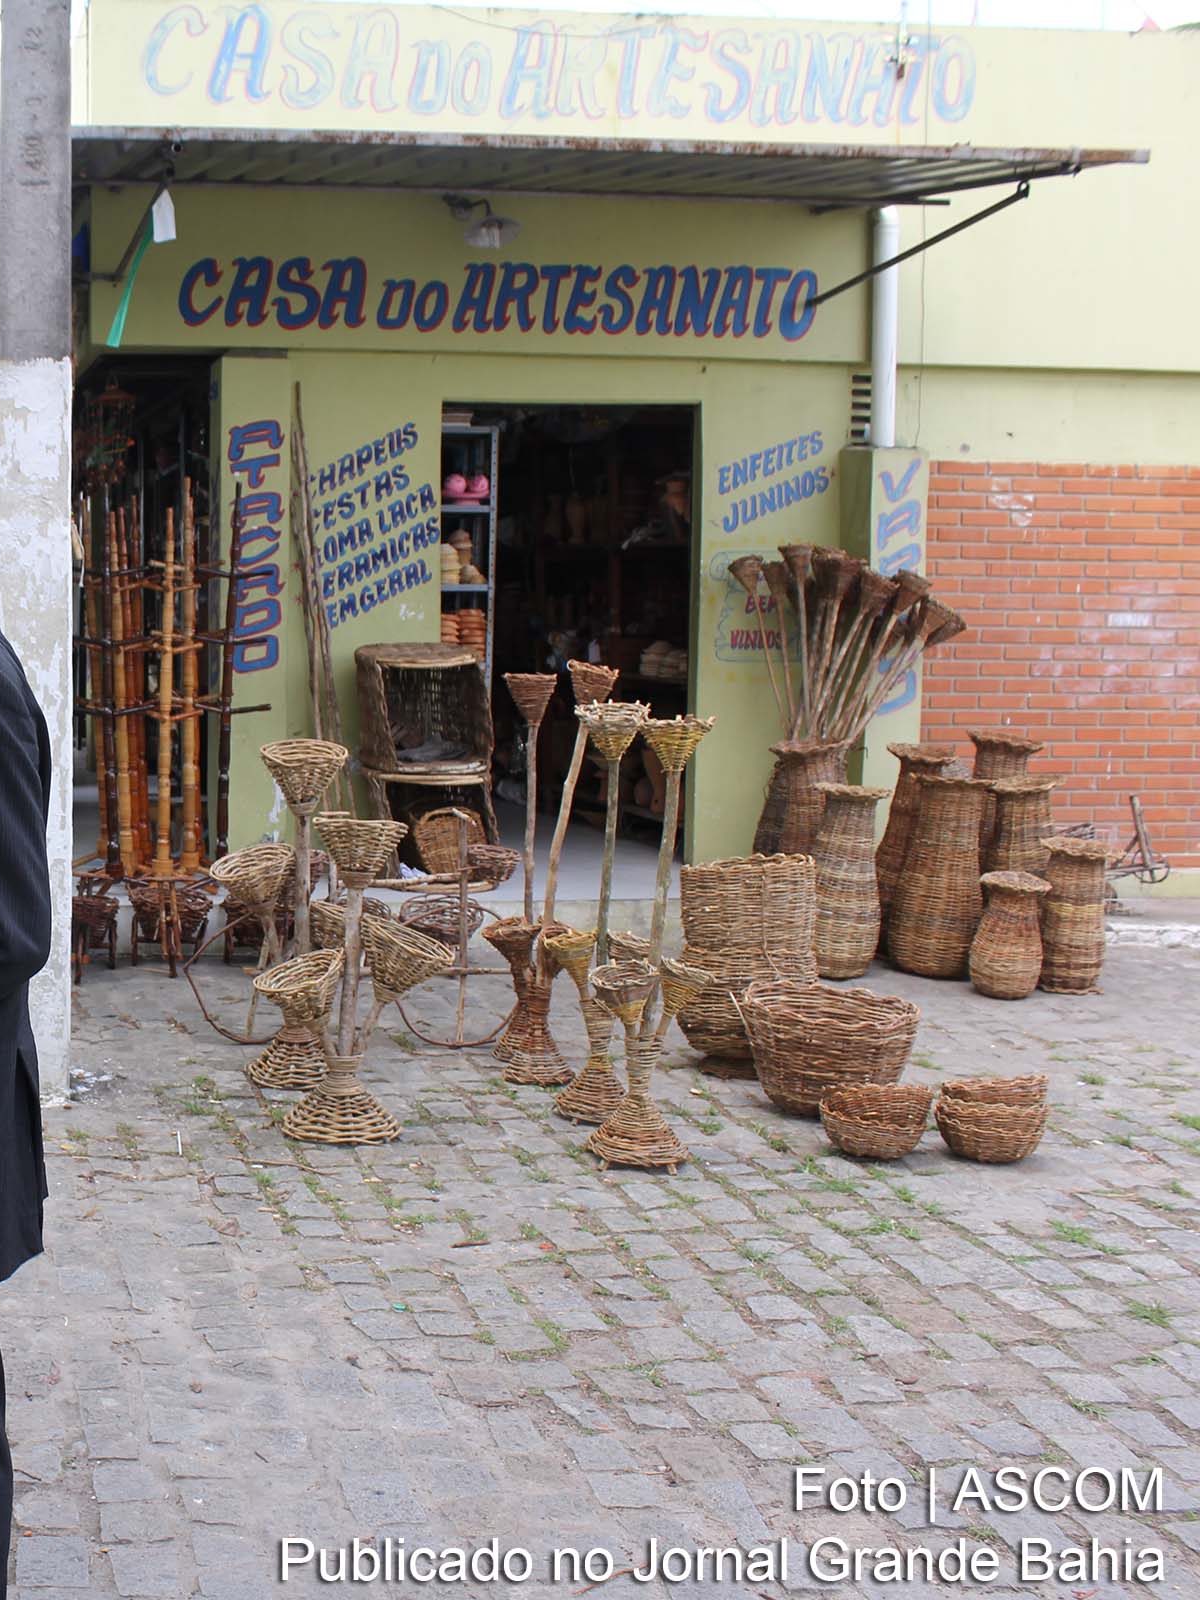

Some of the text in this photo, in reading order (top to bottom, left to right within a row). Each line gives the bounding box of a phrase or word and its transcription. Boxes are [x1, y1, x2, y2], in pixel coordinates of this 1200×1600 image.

[145, 4, 977, 127] CASA DO ARTESANATO
[178, 255, 818, 342] CASA DO ARTESANATO
[717, 430, 825, 495] ENFEITES
[722, 466, 830, 534] JUNINOS
[227, 419, 285, 675] ATACADO
[314, 516, 440, 601] ERAMICAS
